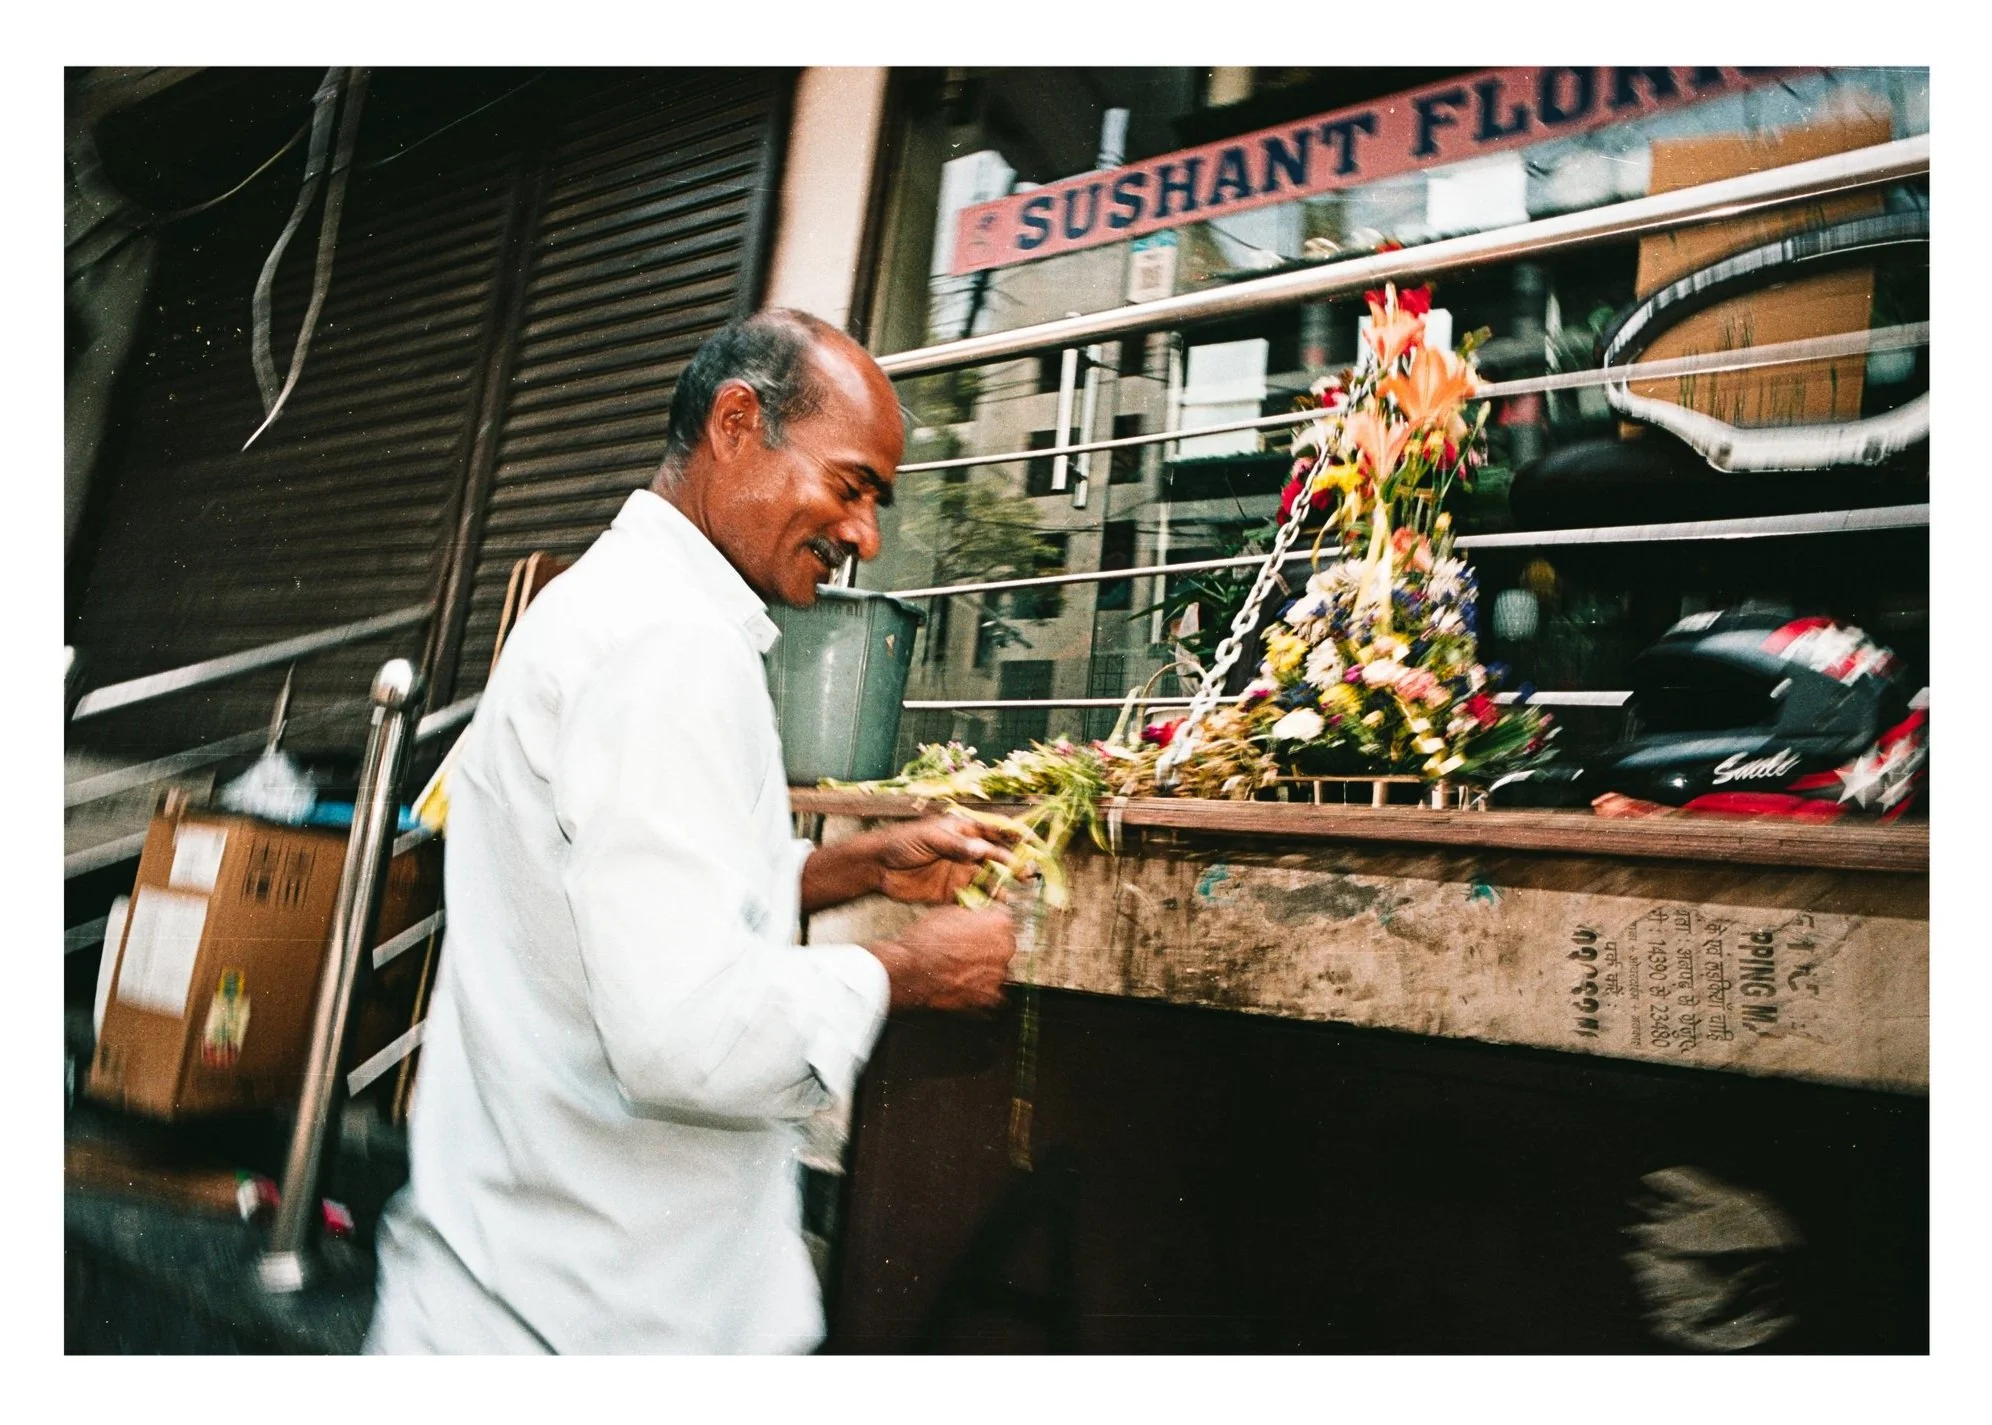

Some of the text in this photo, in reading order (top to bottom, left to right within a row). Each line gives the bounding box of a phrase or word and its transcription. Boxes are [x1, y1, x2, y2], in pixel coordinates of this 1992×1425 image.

[1016, 66, 1795, 251] SUSHANT FLOR
[1648, 940, 1668, 981] 14390
[1650, 986, 1671, 1000] से
[1678, 995, 1700, 1007] से
[1650, 1004, 1670, 1048] 23480
